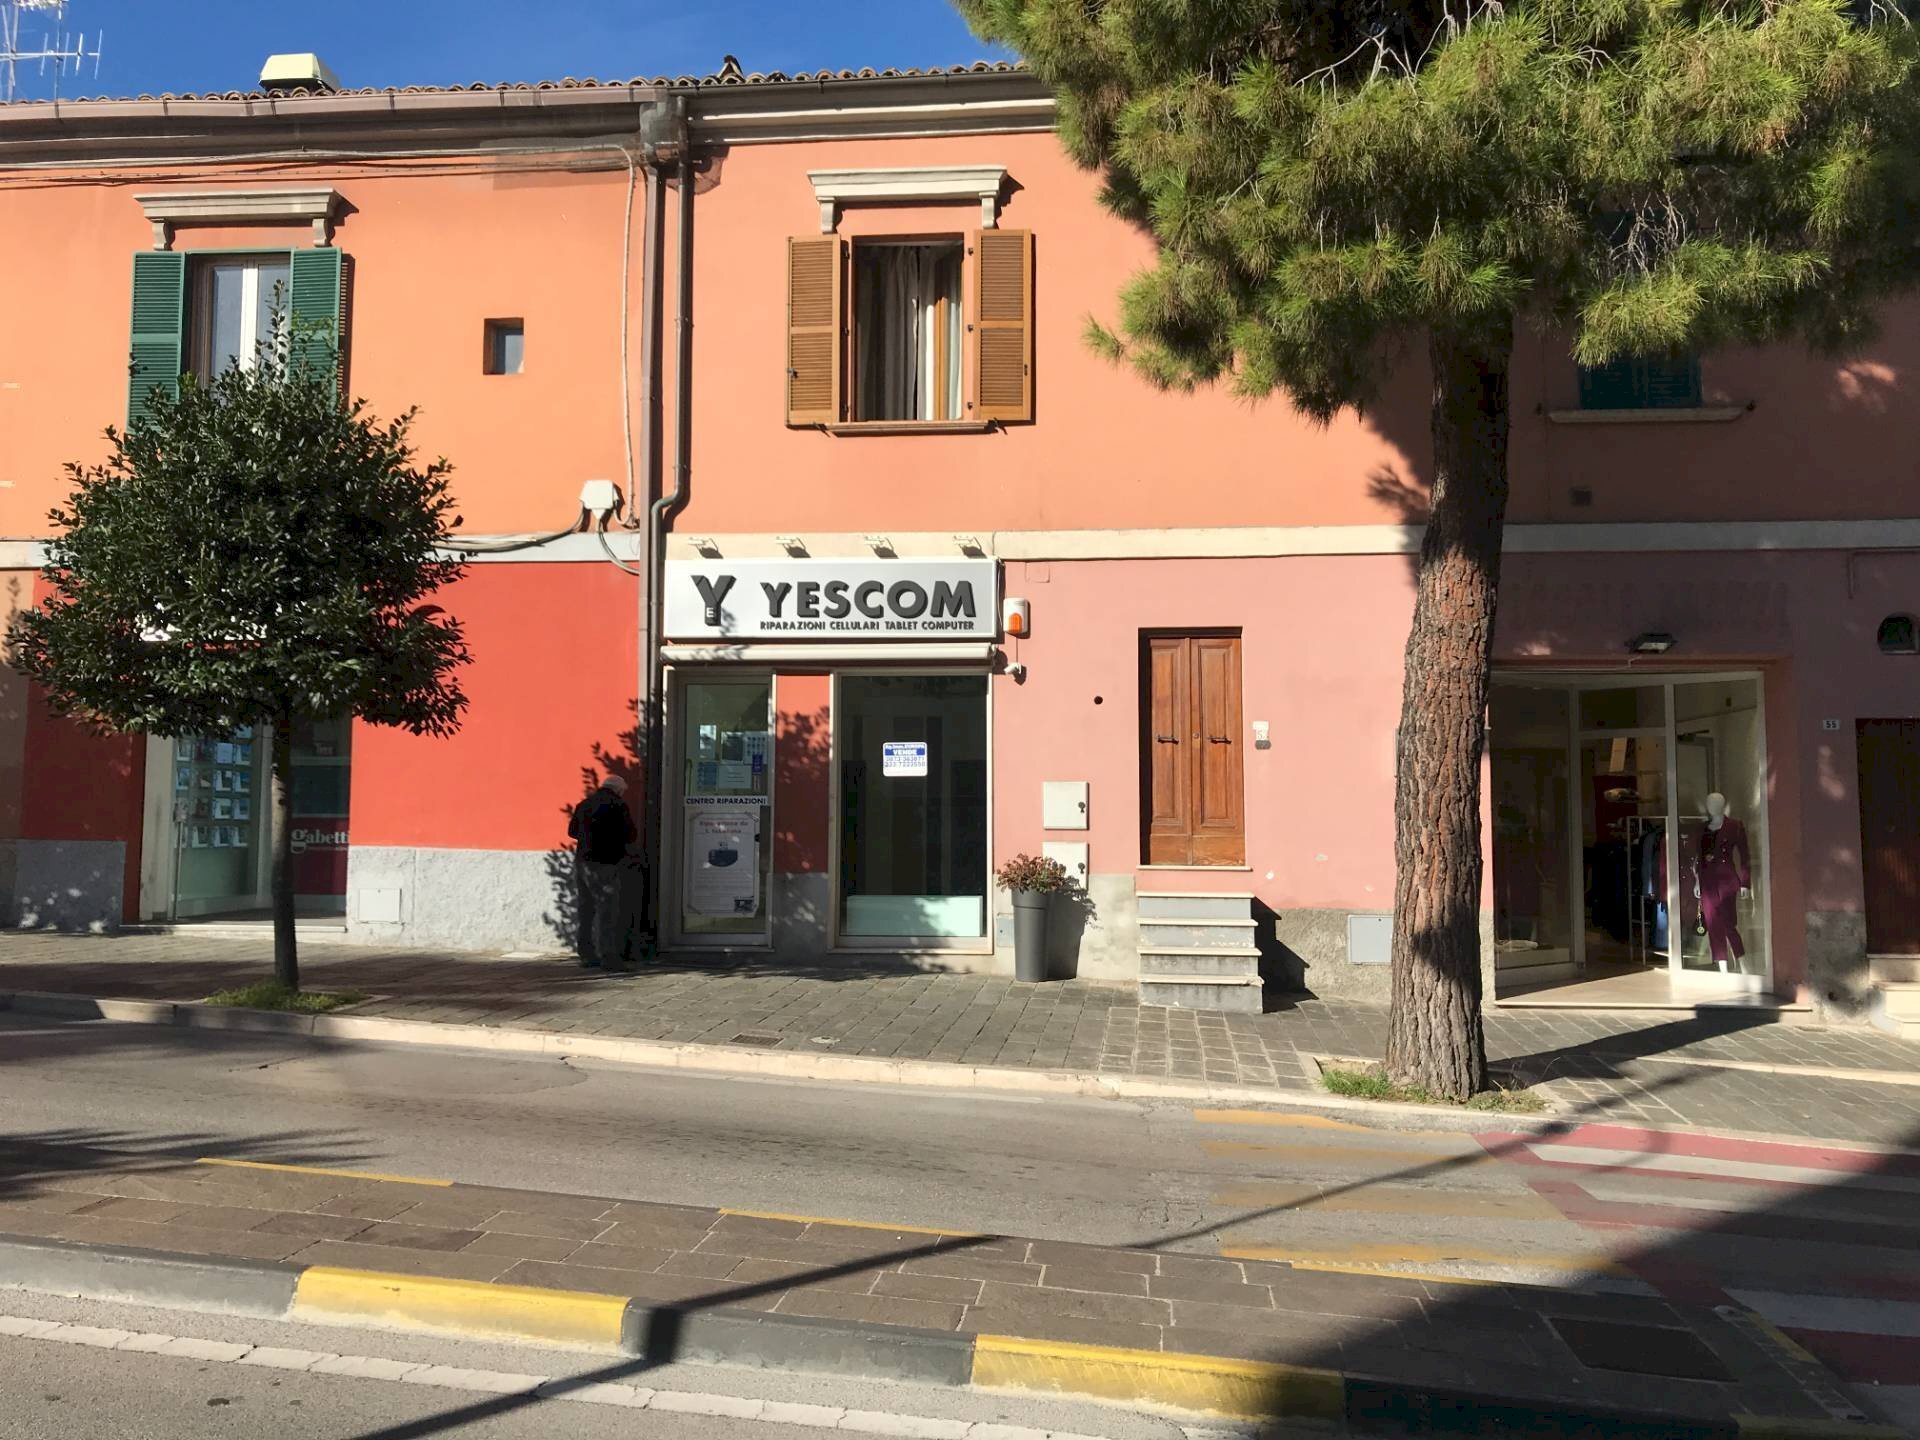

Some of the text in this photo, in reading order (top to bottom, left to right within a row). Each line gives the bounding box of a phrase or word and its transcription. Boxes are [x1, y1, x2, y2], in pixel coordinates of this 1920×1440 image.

[760, 580, 976, 618] YESCOM
[760, 621, 974, 630] RIPARAZIONI CELLULARI TABLET COMPUTER
[1826, 720, 1837, 728] 55
